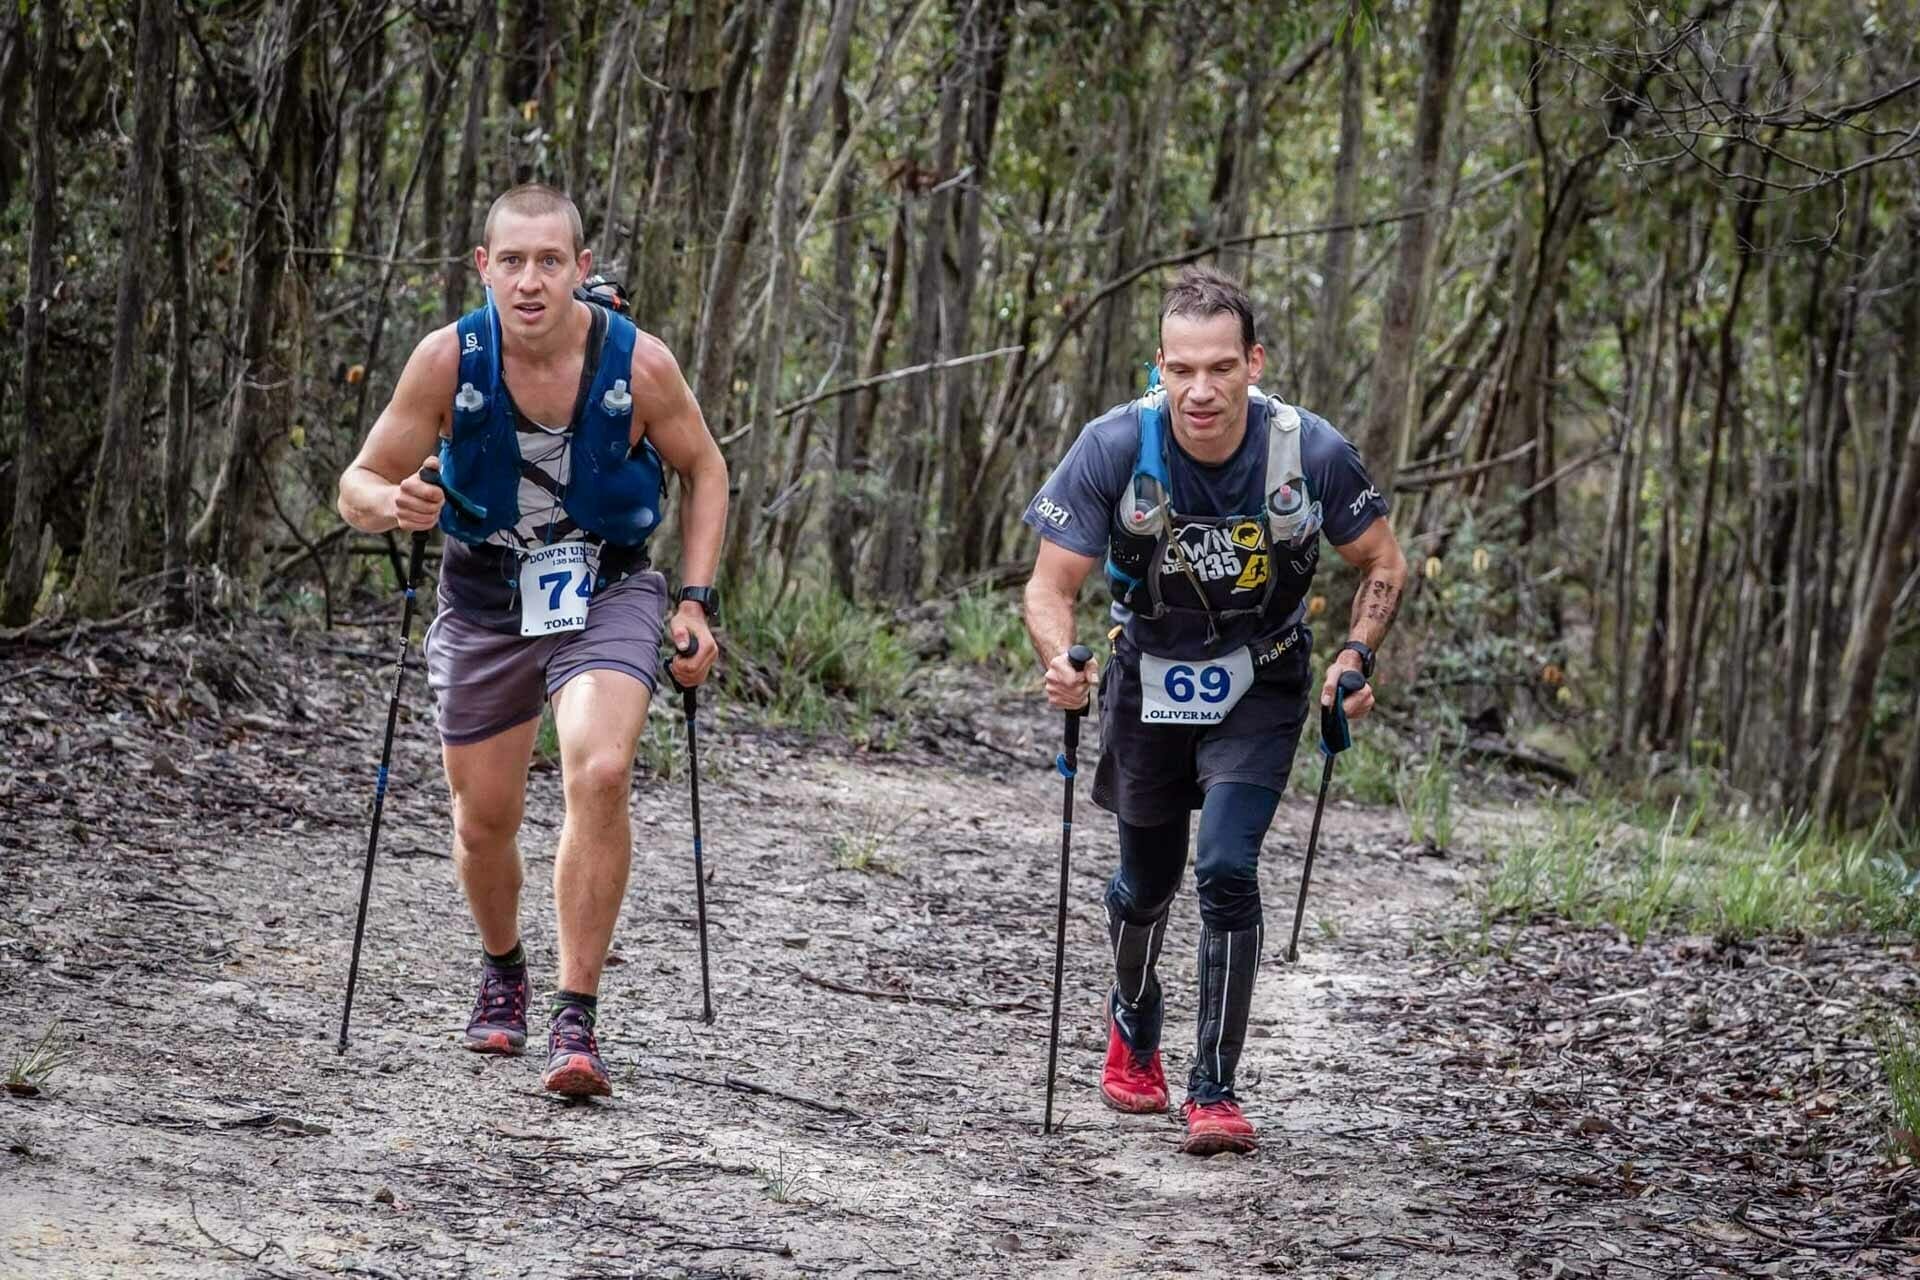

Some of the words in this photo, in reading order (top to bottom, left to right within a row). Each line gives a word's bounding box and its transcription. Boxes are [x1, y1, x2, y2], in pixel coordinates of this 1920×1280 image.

[1038, 497, 1069, 526] 2021
[529, 546, 567, 564] DOWN
[1193, 550, 1242, 582] 135
[539, 570, 592, 610] 74
[544, 616, 574, 630] TOM
[1257, 629, 1300, 667] naked
[1163, 664, 1232, 704] 69
[1149, 709, 1200, 721] OLIVER
